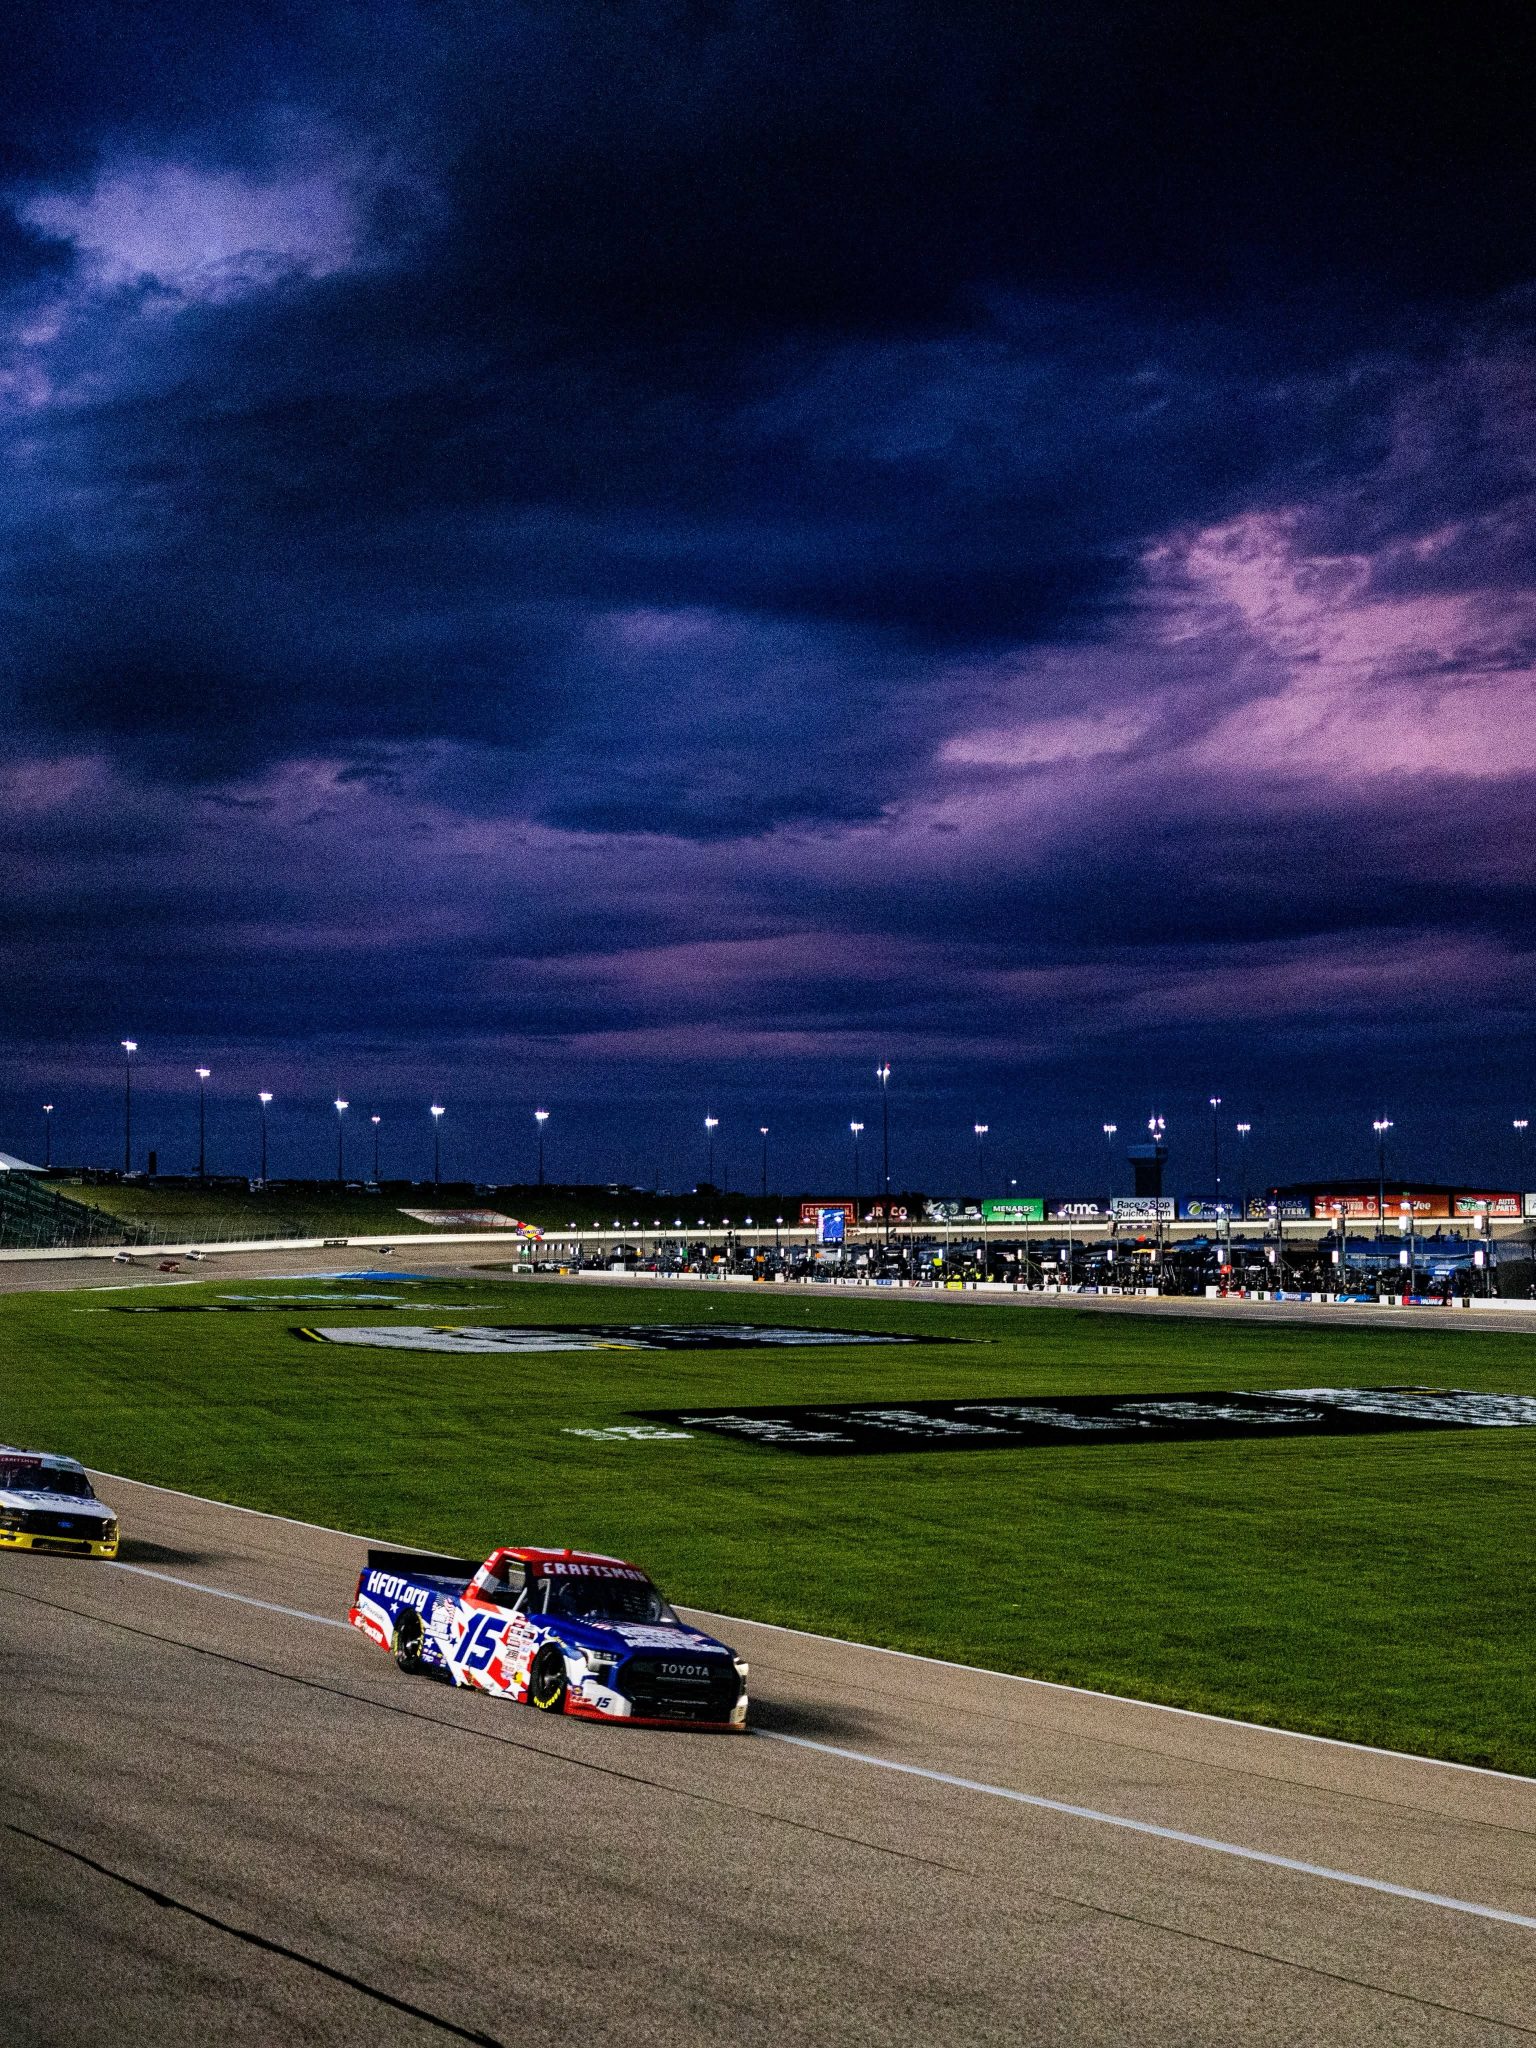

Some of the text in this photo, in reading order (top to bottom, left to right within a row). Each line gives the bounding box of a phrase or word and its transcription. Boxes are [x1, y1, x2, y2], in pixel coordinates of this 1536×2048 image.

[1117, 1200, 1140, 1209] Race
[1149, 1200, 1170, 1209] Sop
[1271, 1200, 1302, 1208] KANSAS
[869, 1207, 907, 1216] JR CO
[543, 1562, 649, 1583] CRAFTSMAN
[367, 1570, 430, 1613] HFOT.org
[453, 1613, 508, 1671] 15
[661, 1663, 710, 1676] TOYOTA
[596, 1697, 612, 1708] 15
